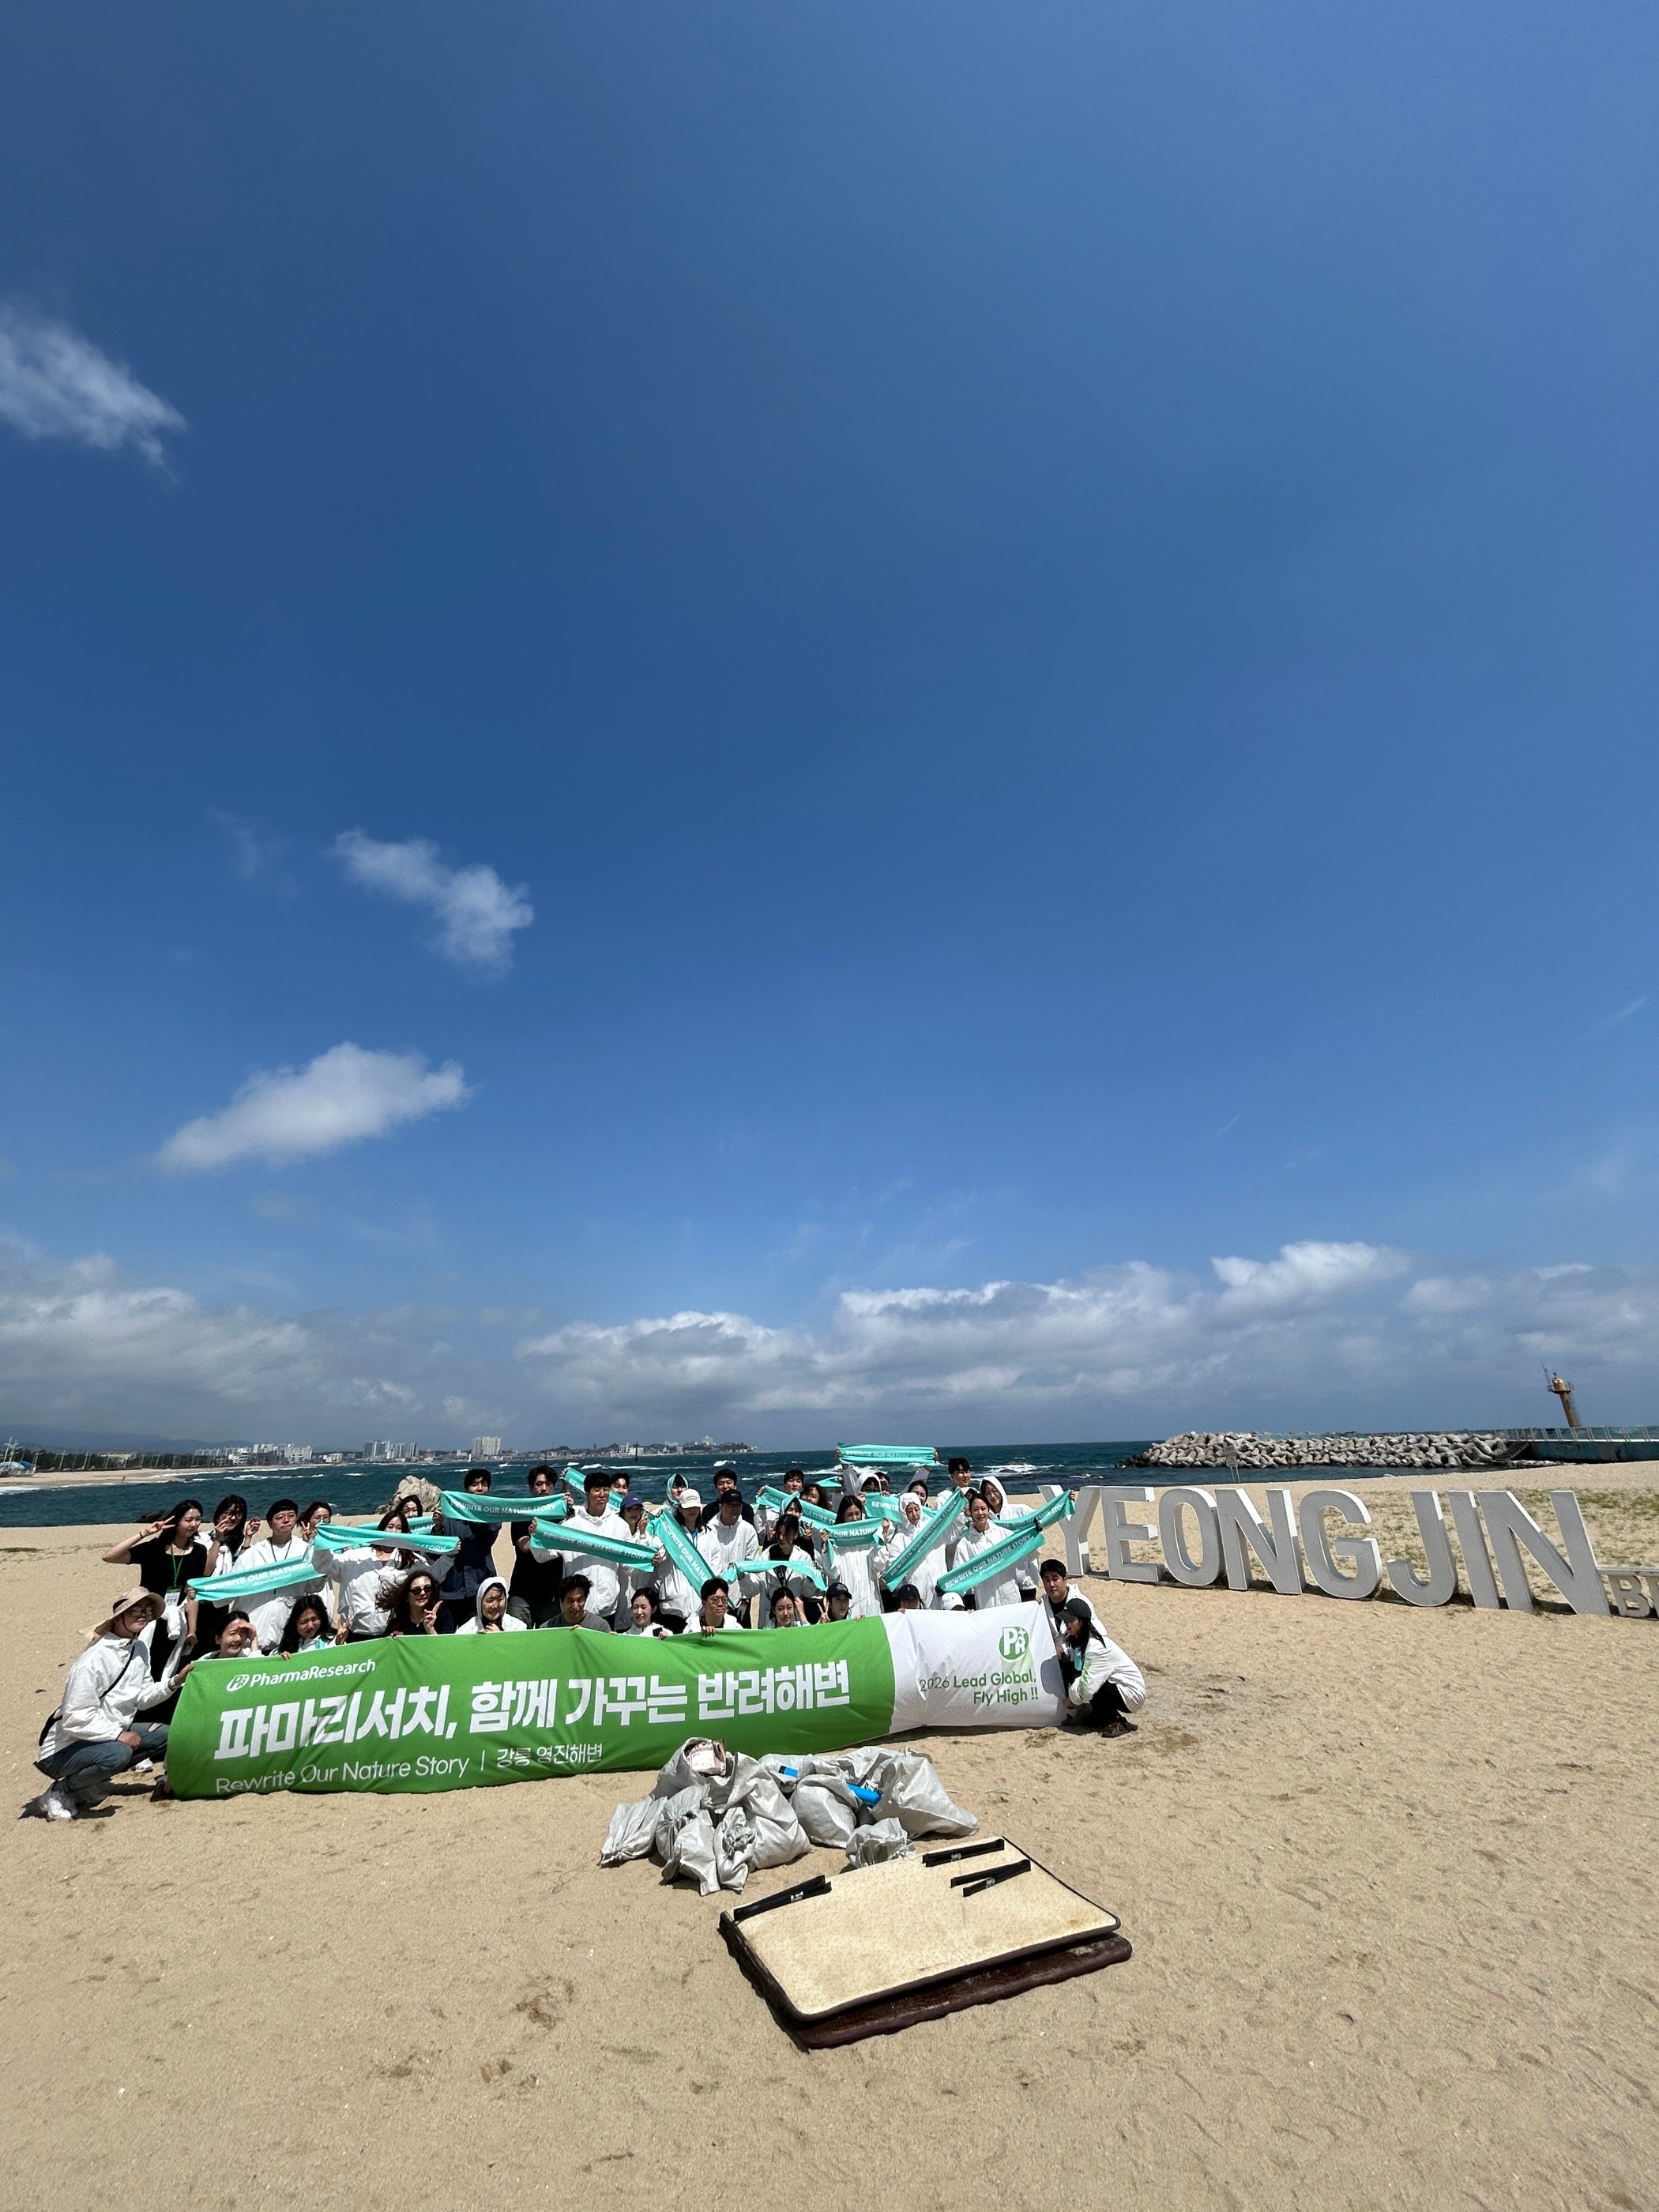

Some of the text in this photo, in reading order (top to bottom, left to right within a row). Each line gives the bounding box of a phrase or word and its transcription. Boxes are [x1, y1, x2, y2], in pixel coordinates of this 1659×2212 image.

[681, 1547, 694, 1564] OUR
[944, 1569, 973, 1589] REWRITE
[972, 1559, 988, 1572] OUR
[987, 1544, 1013, 1564] NATURE
[1012, 1533, 1032, 1549] STORY
[247, 1571, 268, 1582] OUR
[250, 1658, 376, 1687] PharmaResearch
[919, 1668, 1036, 1692] 2026 Lead Global,
[214, 1659, 850, 1759] 파마리서치, 함께 가꾸는 반려해변
[973, 1691, 993, 1706] Fly
[996, 1688, 1028, 1706] High
[496, 1743, 603, 1769] 강릉 영진해변
[216, 1755, 470, 1794] Rewrite Our Nature Story
